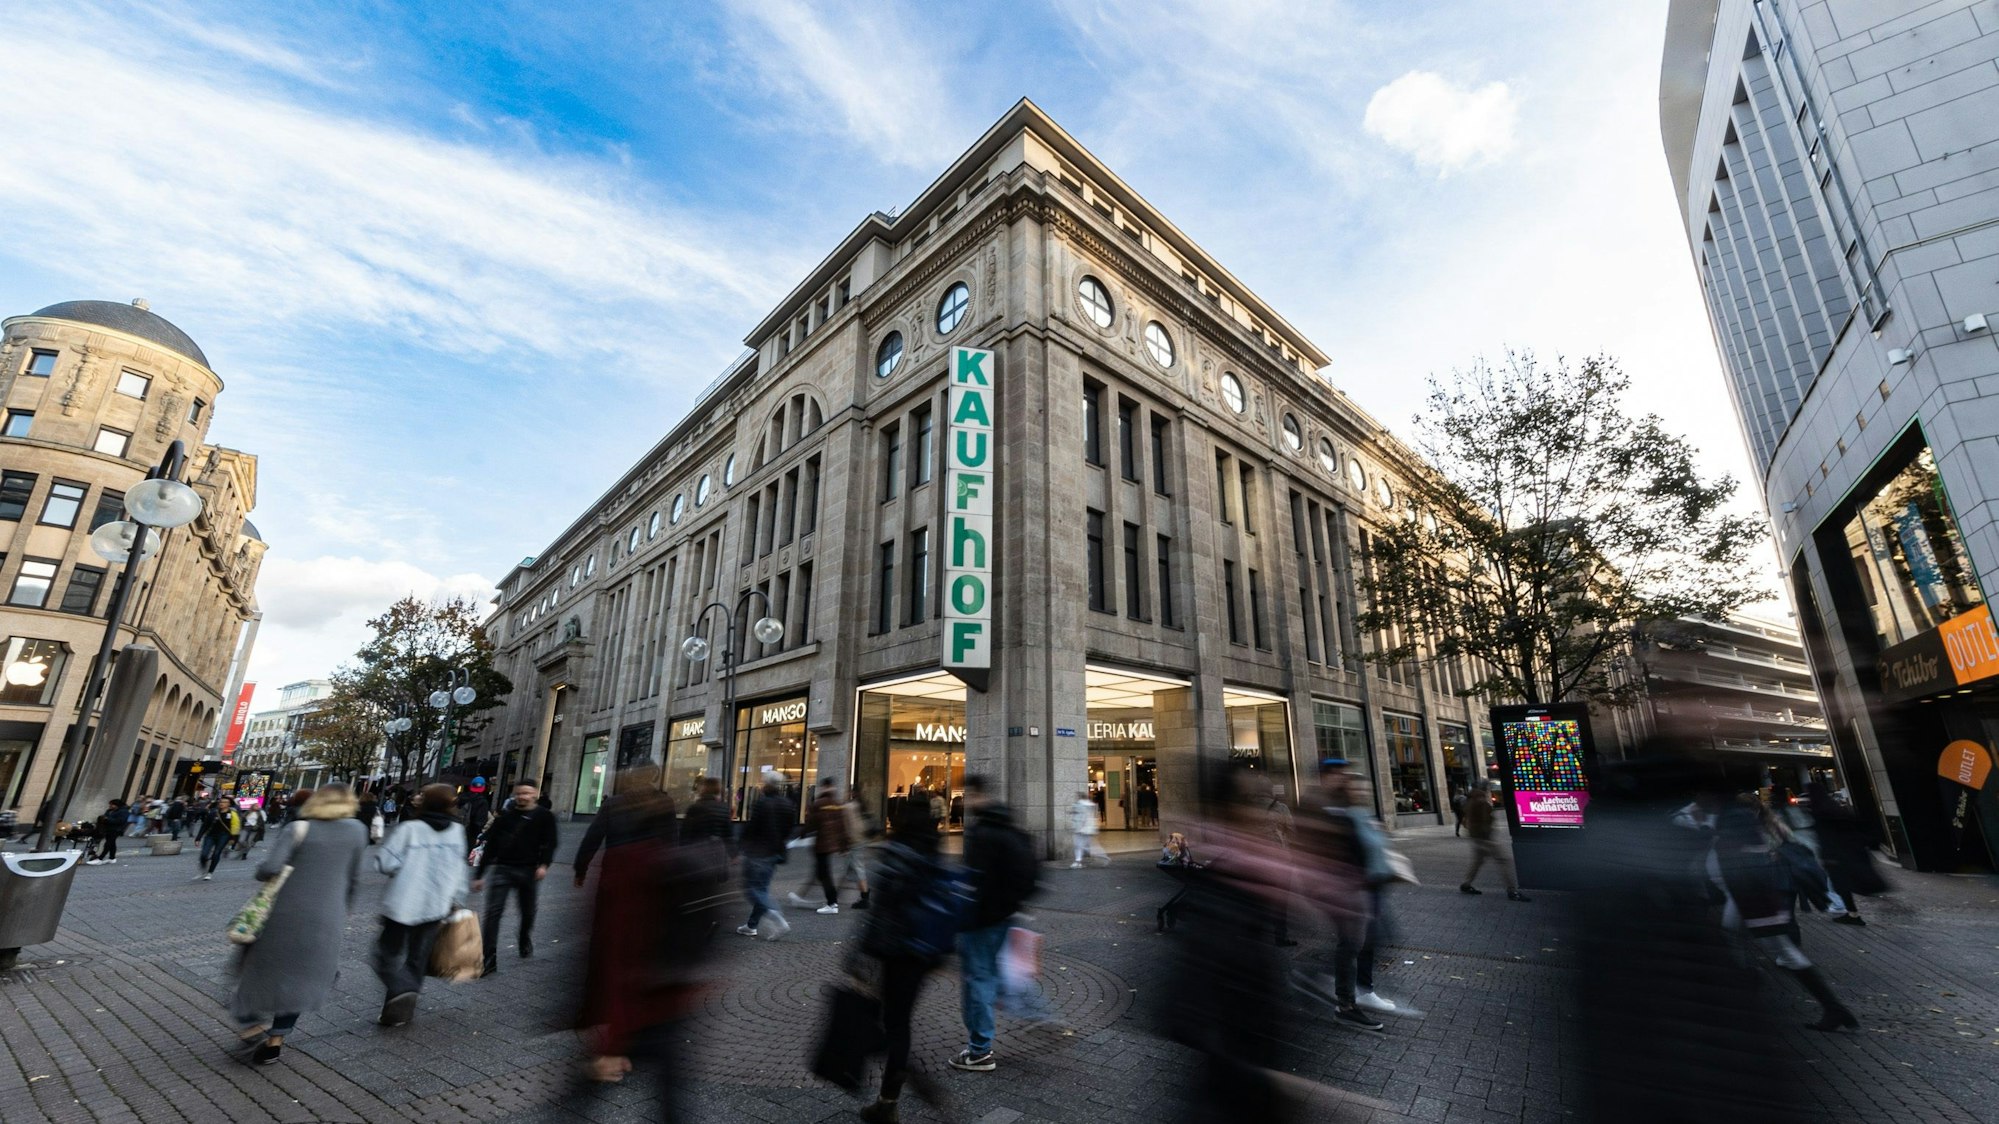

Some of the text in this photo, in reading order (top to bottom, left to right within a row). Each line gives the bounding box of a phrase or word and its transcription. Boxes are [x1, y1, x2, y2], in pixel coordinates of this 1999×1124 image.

[1892, 653, 1938, 688] Tchibo
[234, 701, 249, 725] UNIQLO
[762, 702, 807, 724] MANGO
[1958, 748, 1975, 783] OUTLET
